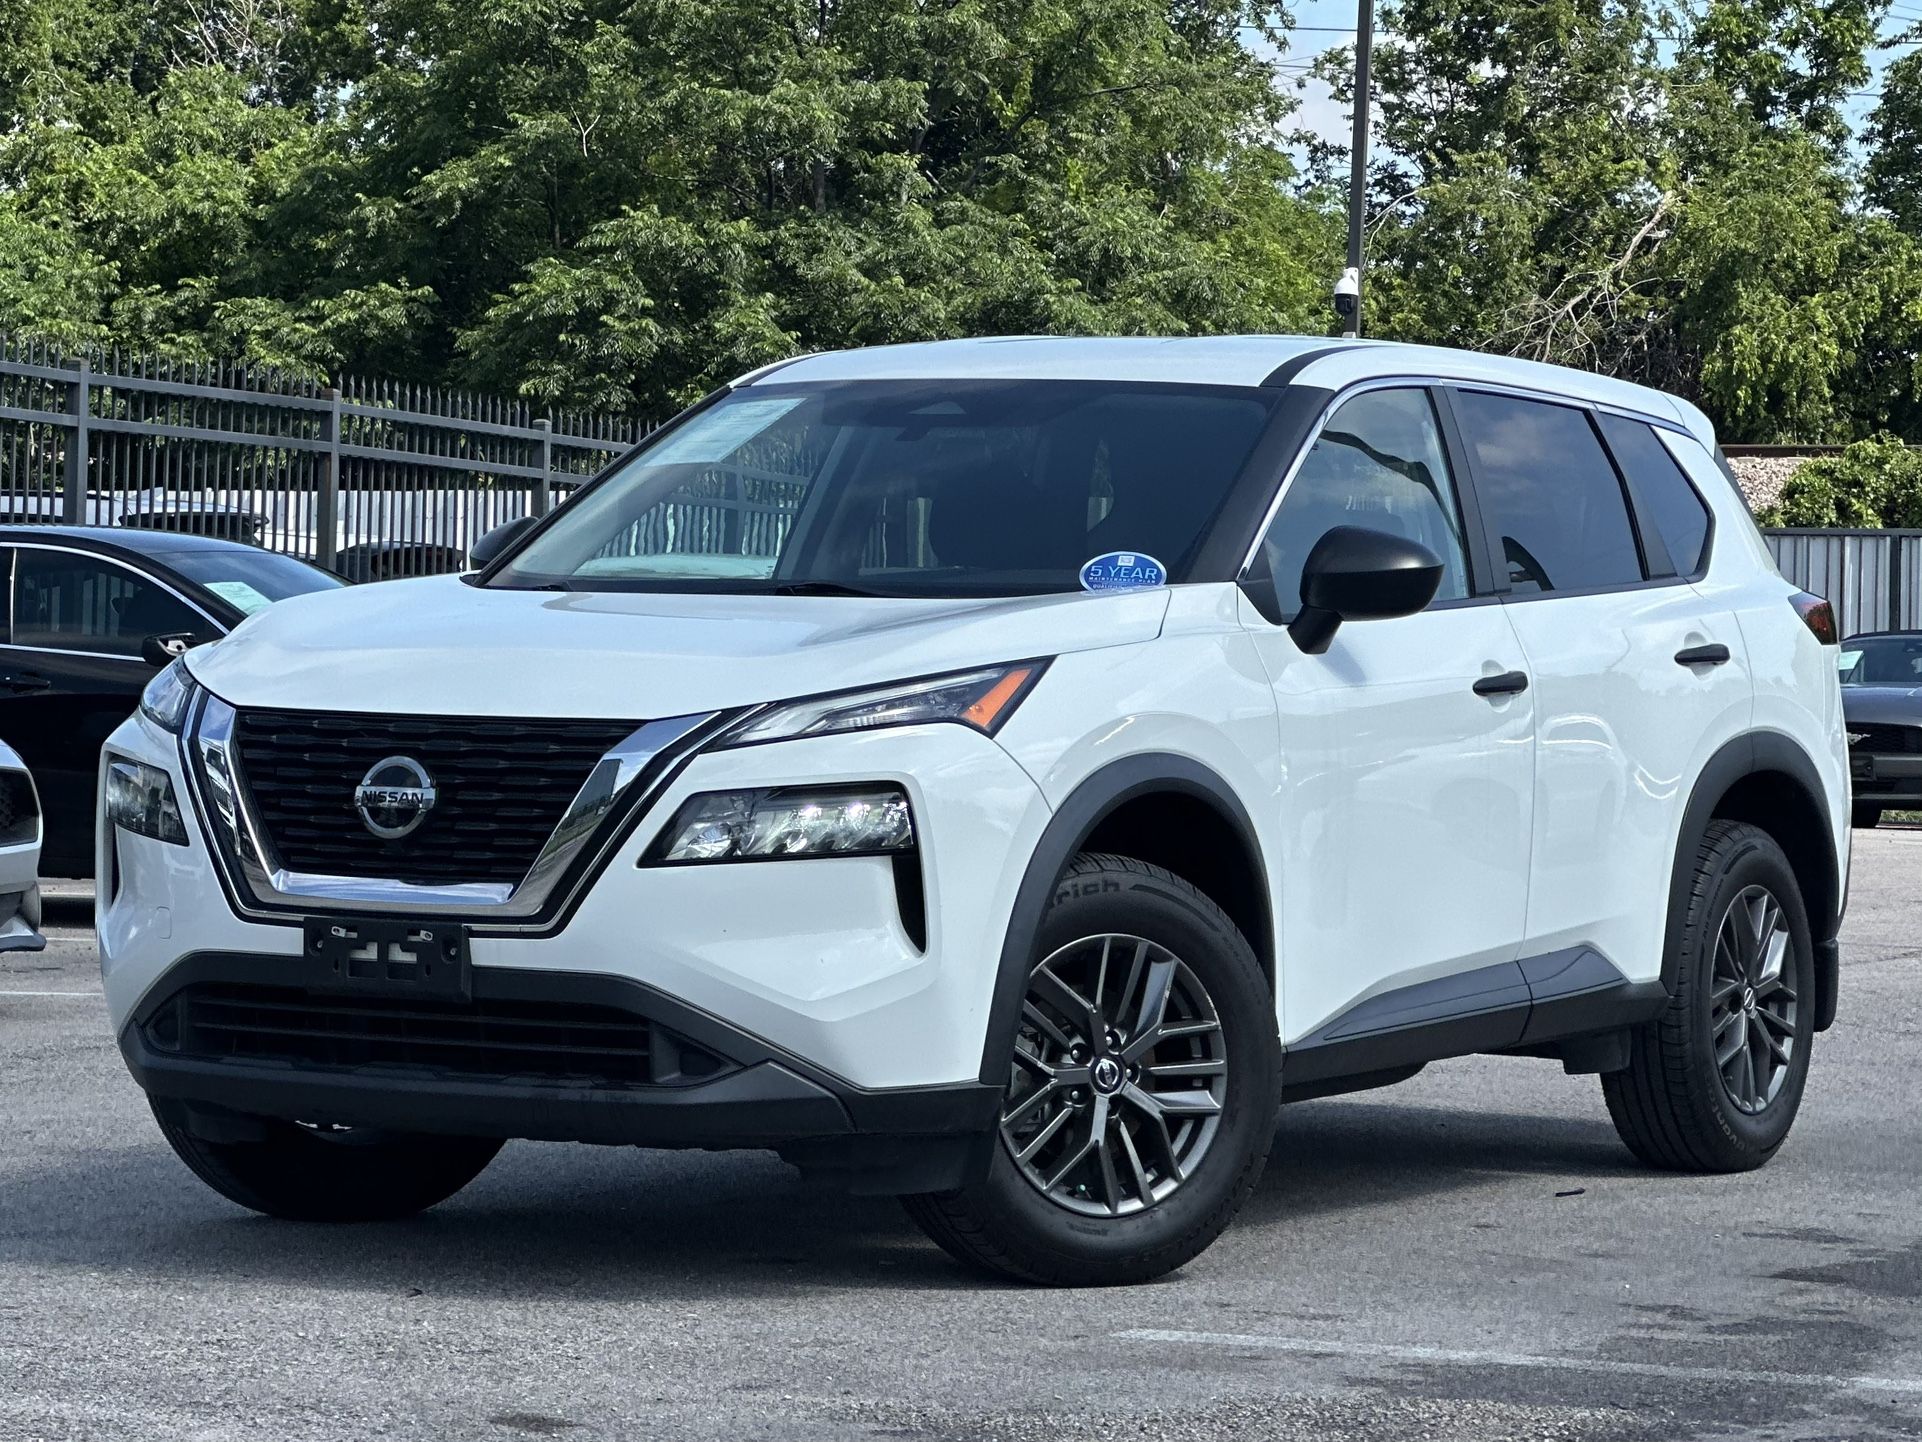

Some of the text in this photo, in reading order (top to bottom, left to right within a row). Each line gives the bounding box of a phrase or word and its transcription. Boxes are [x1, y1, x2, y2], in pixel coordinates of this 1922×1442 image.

[1090, 565, 1158, 580] 5 YEAR
[361, 790, 424, 804] NISSAN
[1053, 878, 1119, 906] rich
